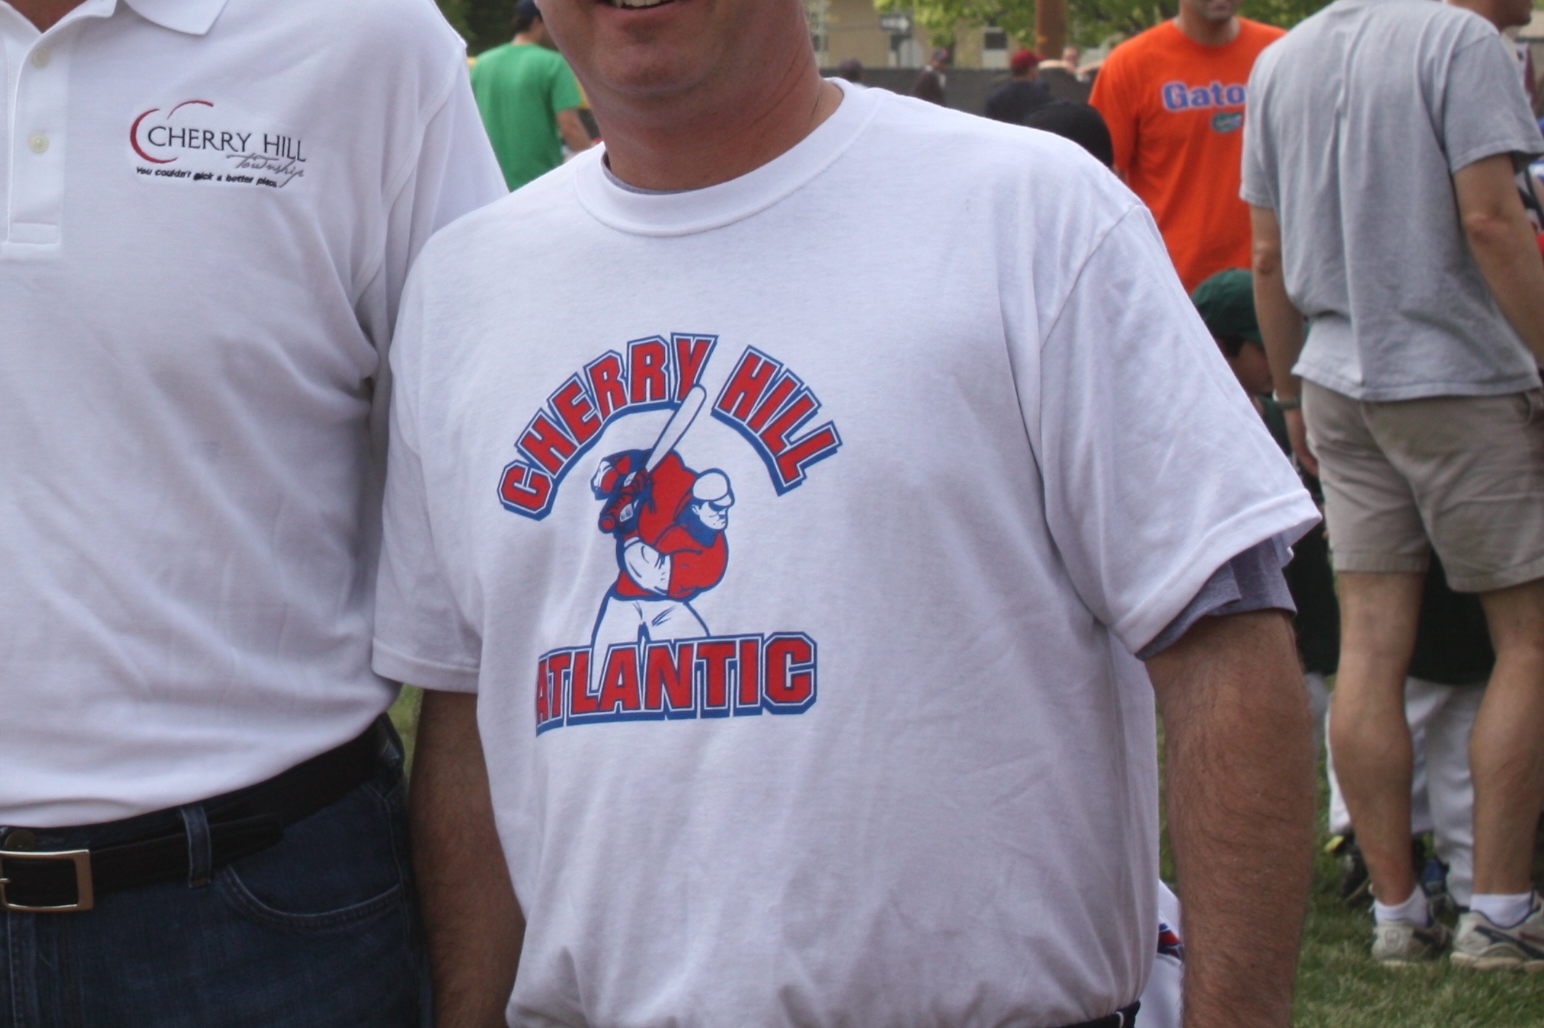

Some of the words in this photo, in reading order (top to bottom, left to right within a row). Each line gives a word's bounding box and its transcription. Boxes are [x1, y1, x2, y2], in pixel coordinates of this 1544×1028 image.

[1162, 80, 1248, 112] Gato
[148, 125, 252, 153] CHERRY
[264, 133, 306, 162] HILL
[225, 174, 254, 184] better
[497, 332, 719, 521] CHERRY
[711, 345, 843, 497] HILL
[536, 632, 817, 737] ATLANTIC
